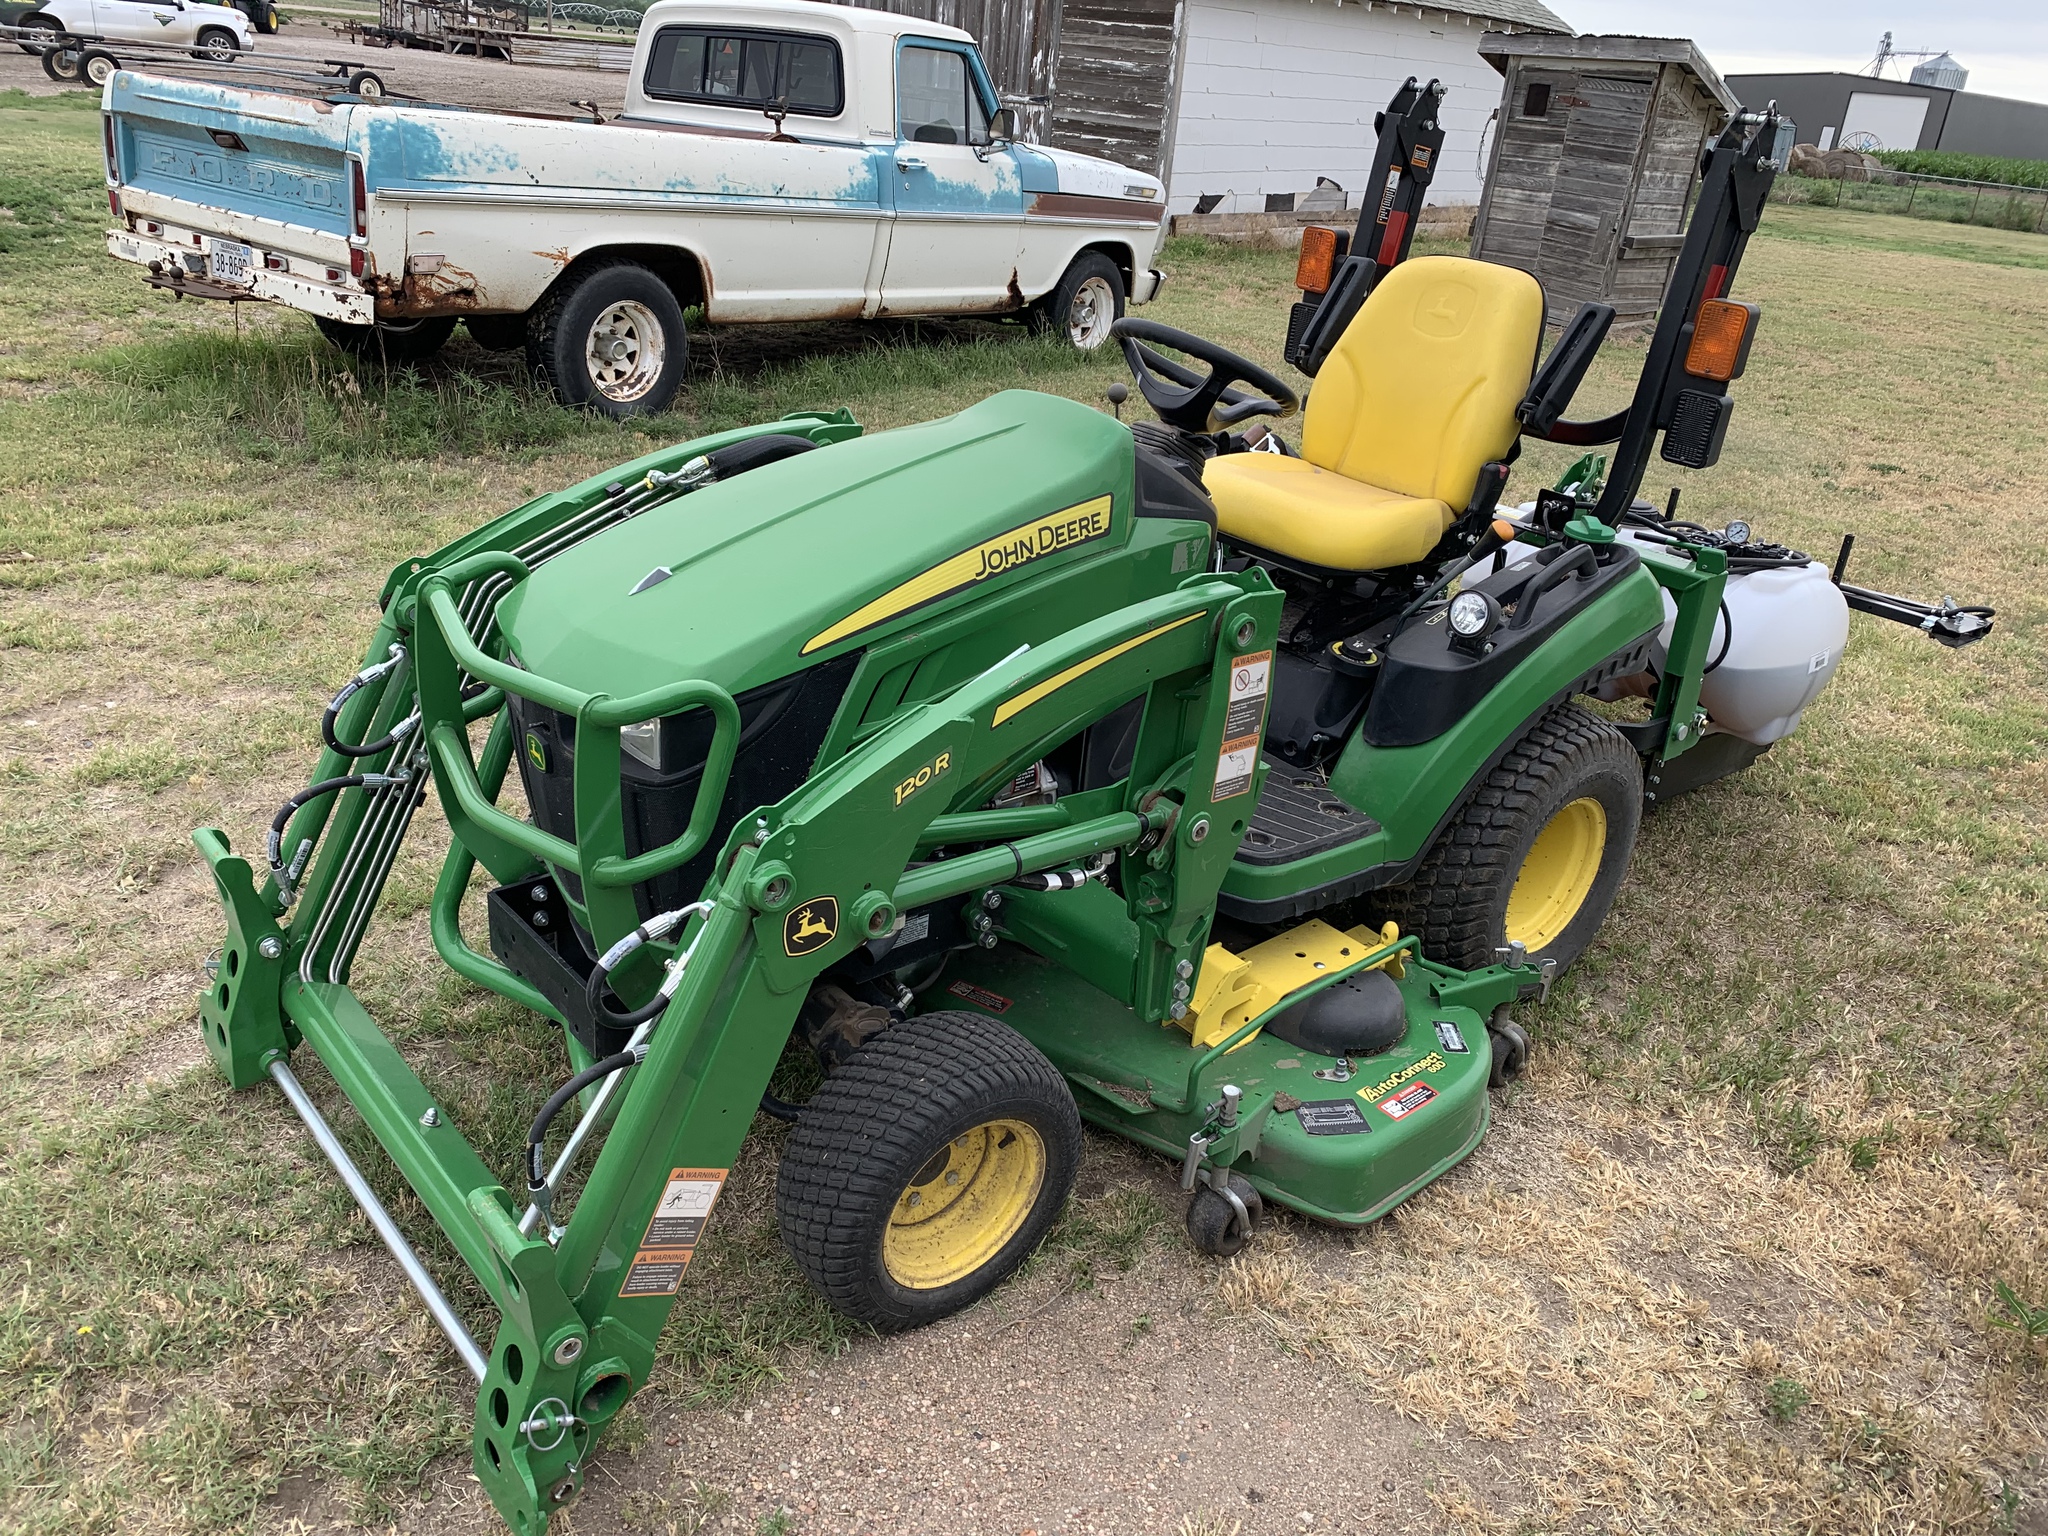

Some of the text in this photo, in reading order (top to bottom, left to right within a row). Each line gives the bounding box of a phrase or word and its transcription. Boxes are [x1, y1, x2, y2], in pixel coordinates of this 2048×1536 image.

[152, 150, 333, 207] FORD
[975, 511, 1103, 578] JOHN DEERE
[1240, 651, 1270, 665] WARNING
[1228, 738, 1258, 752] WARNING
[894, 751, 951, 807] 120 R
[1363, 1050, 1443, 1103] AutoConnect
[1426, 1060, 1447, 1073] 60D
[685, 1171, 721, 1179] WARNING
